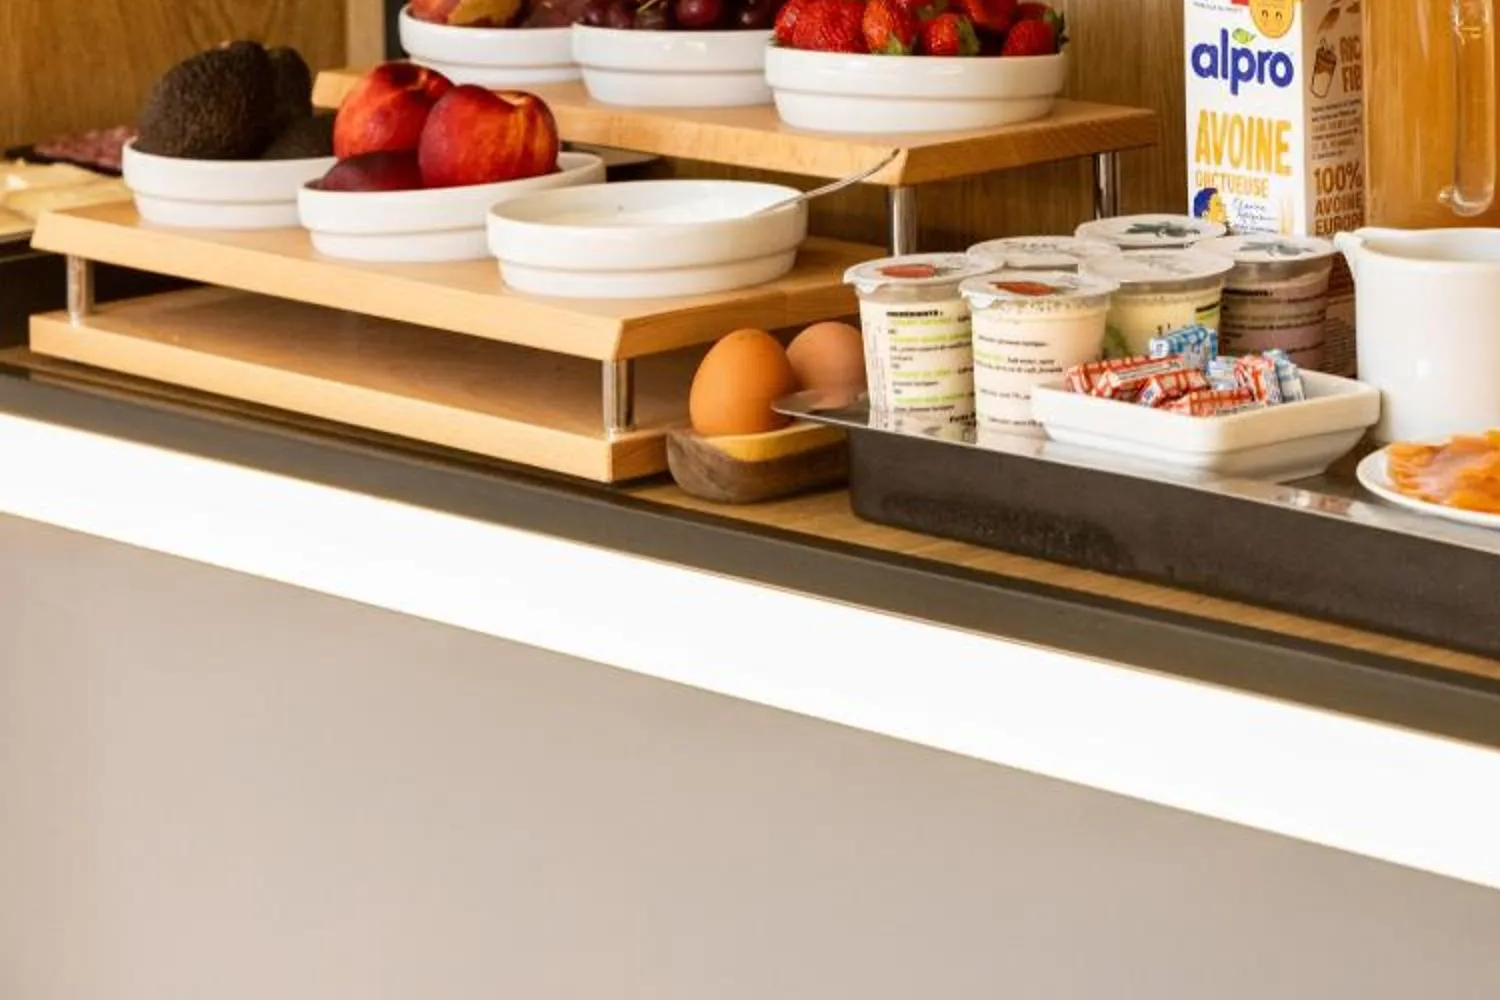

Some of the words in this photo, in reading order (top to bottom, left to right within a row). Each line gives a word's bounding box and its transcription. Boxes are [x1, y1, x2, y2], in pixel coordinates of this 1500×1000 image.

[1191, 28, 1294, 95] alpro
[1195, 109, 1292, 176] AVOINE
[1313, 161, 1363, 195] 100%
[1315, 190, 1364, 216] AVOINE
